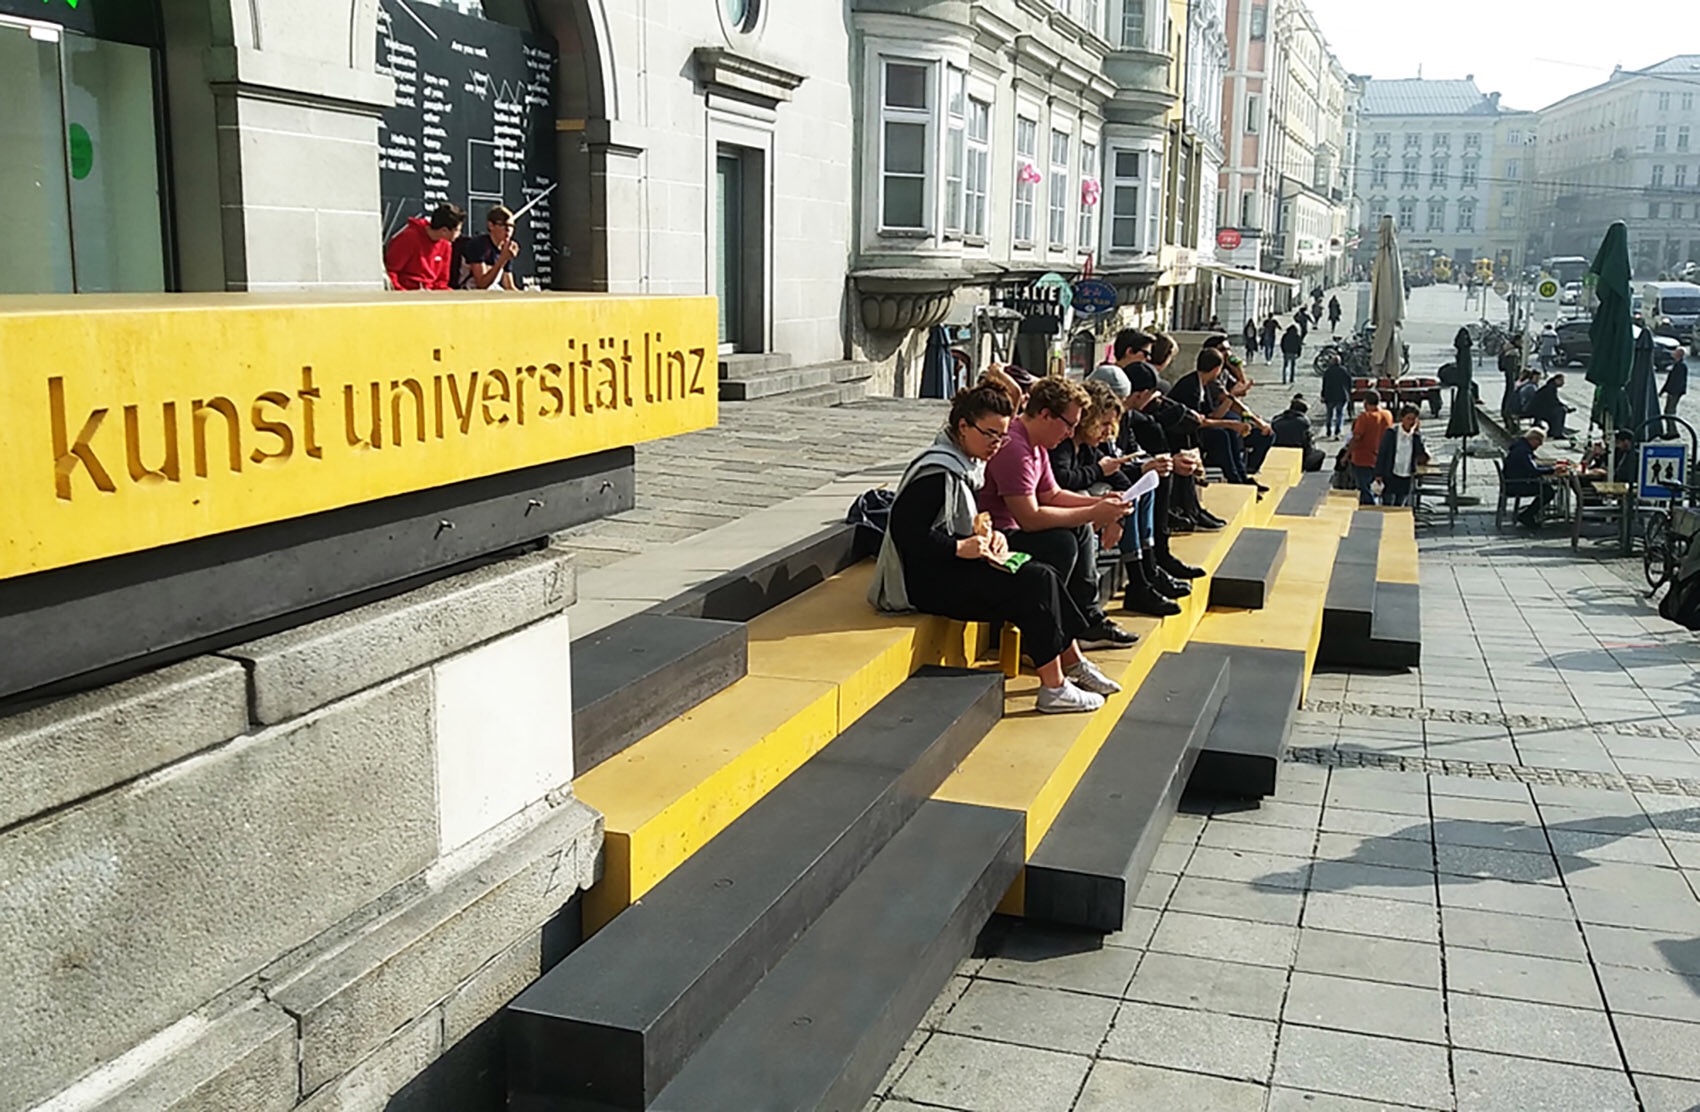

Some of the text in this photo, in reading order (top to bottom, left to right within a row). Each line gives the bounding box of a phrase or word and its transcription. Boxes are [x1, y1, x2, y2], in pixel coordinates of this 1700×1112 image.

[47, 332, 705, 501] kunst universität linz
